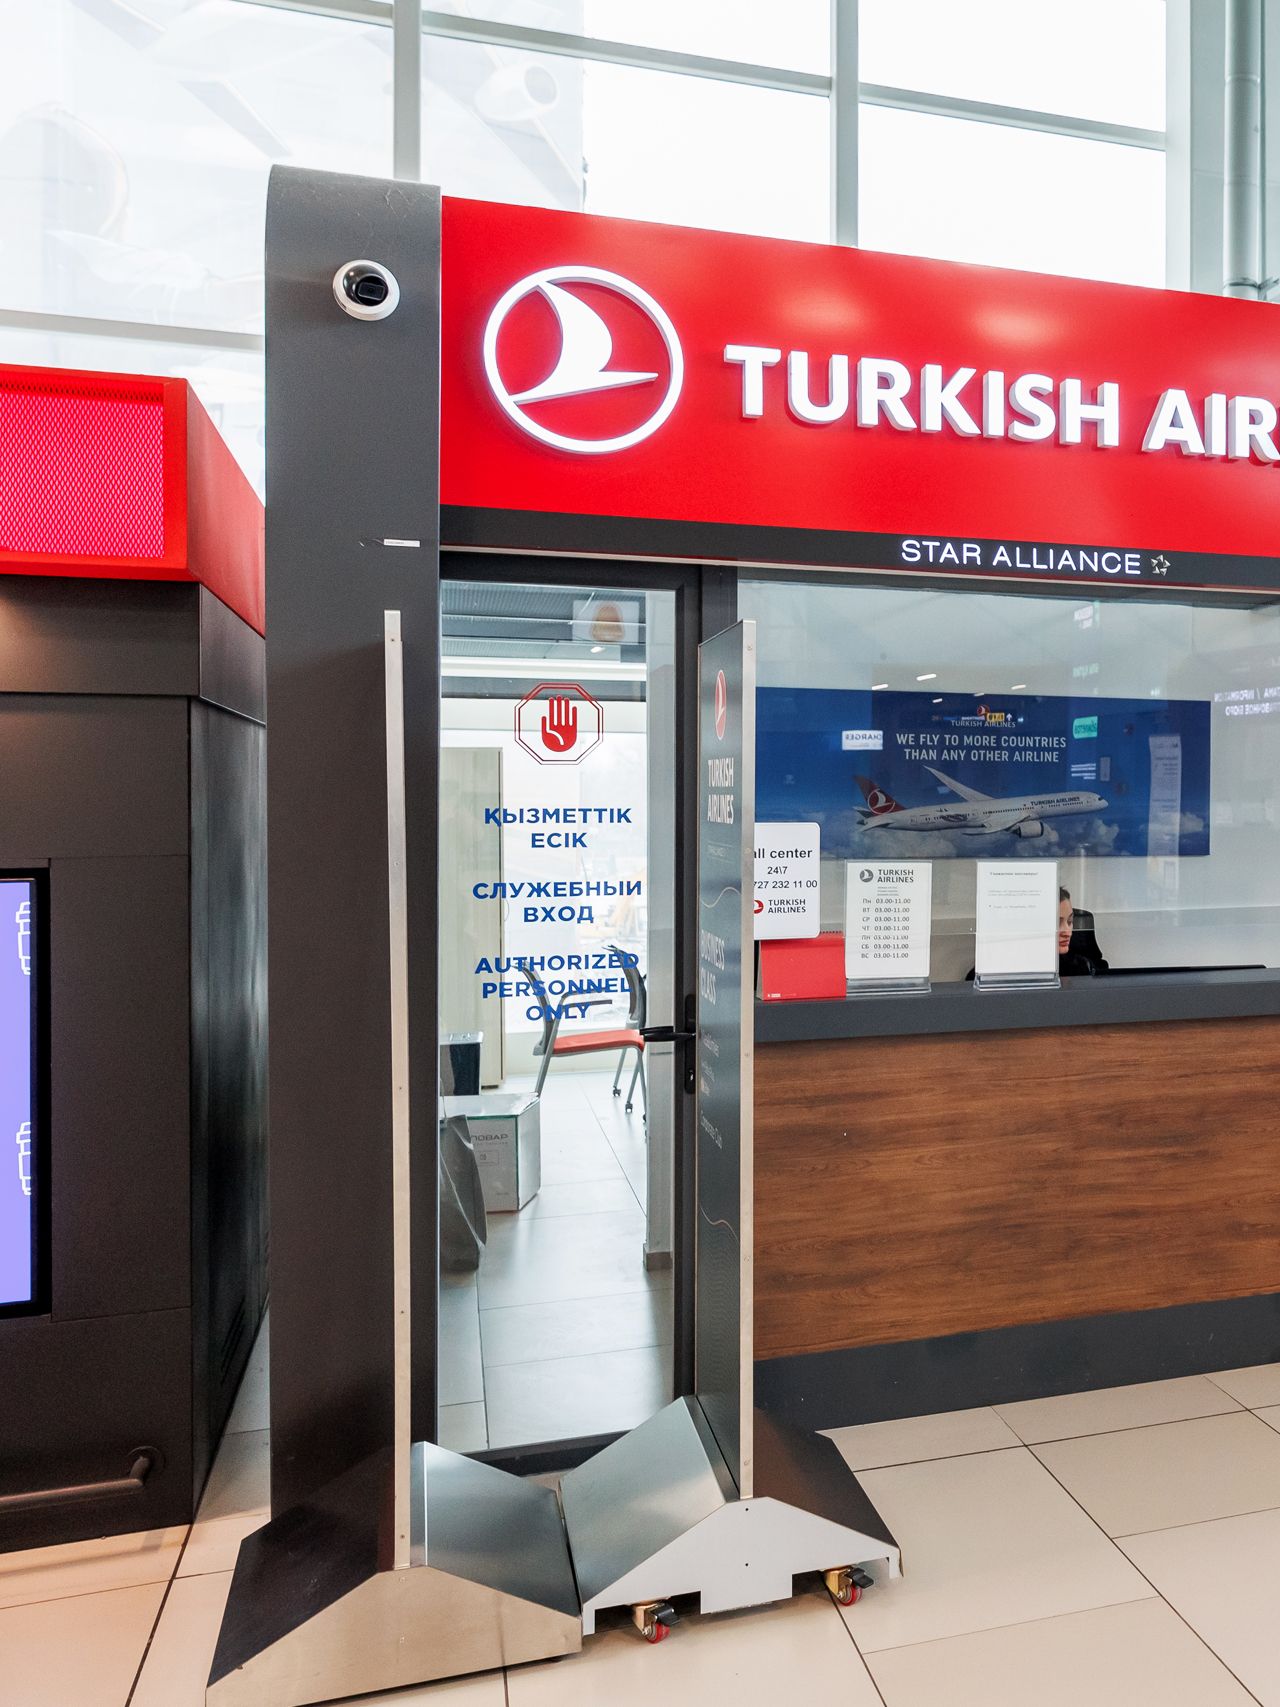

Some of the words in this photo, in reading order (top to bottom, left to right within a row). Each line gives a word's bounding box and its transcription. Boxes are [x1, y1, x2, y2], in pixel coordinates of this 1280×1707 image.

[722, 344, 1120, 448] TURKISH
[901, 539, 982, 566] STAR
[992, 545, 1141, 575] ALLIANCE
[984, 720, 1016, 728] AIRLINES
[896, 733, 915, 745] WE
[919, 734, 940, 745] FLY
[944, 735, 959, 745] TO
[963, 735, 997, 746] MORE
[1001, 736, 1067, 748] COUNTRIES
[904, 748, 937, 760] THAN
[941, 749, 966, 761] ANY
[970, 750, 1009, 762] OTHER
[1013, 751, 1059, 762] AIRLINE
[708, 757, 734, 787] TURKISH
[484, 808, 632, 827] ҚЫЗМЕТТІК
[707, 794, 734, 824] AIRLINES
[531, 832, 588, 848] ЕСІК
[770, 848, 813, 858] center
[767, 866, 788, 874] 24\7
[793, 880, 803, 888] 11
[806, 880, 817, 888] 00
[768, 898, 806, 906] TURKISH
[768, 906, 806, 914] AIRLINES
[523, 906, 594, 924] ВХОД
[474, 953, 640, 974] AUTHORIZED
[482, 977, 632, 998] PERSONNEL
[525, 1002, 592, 1021] ONLY
